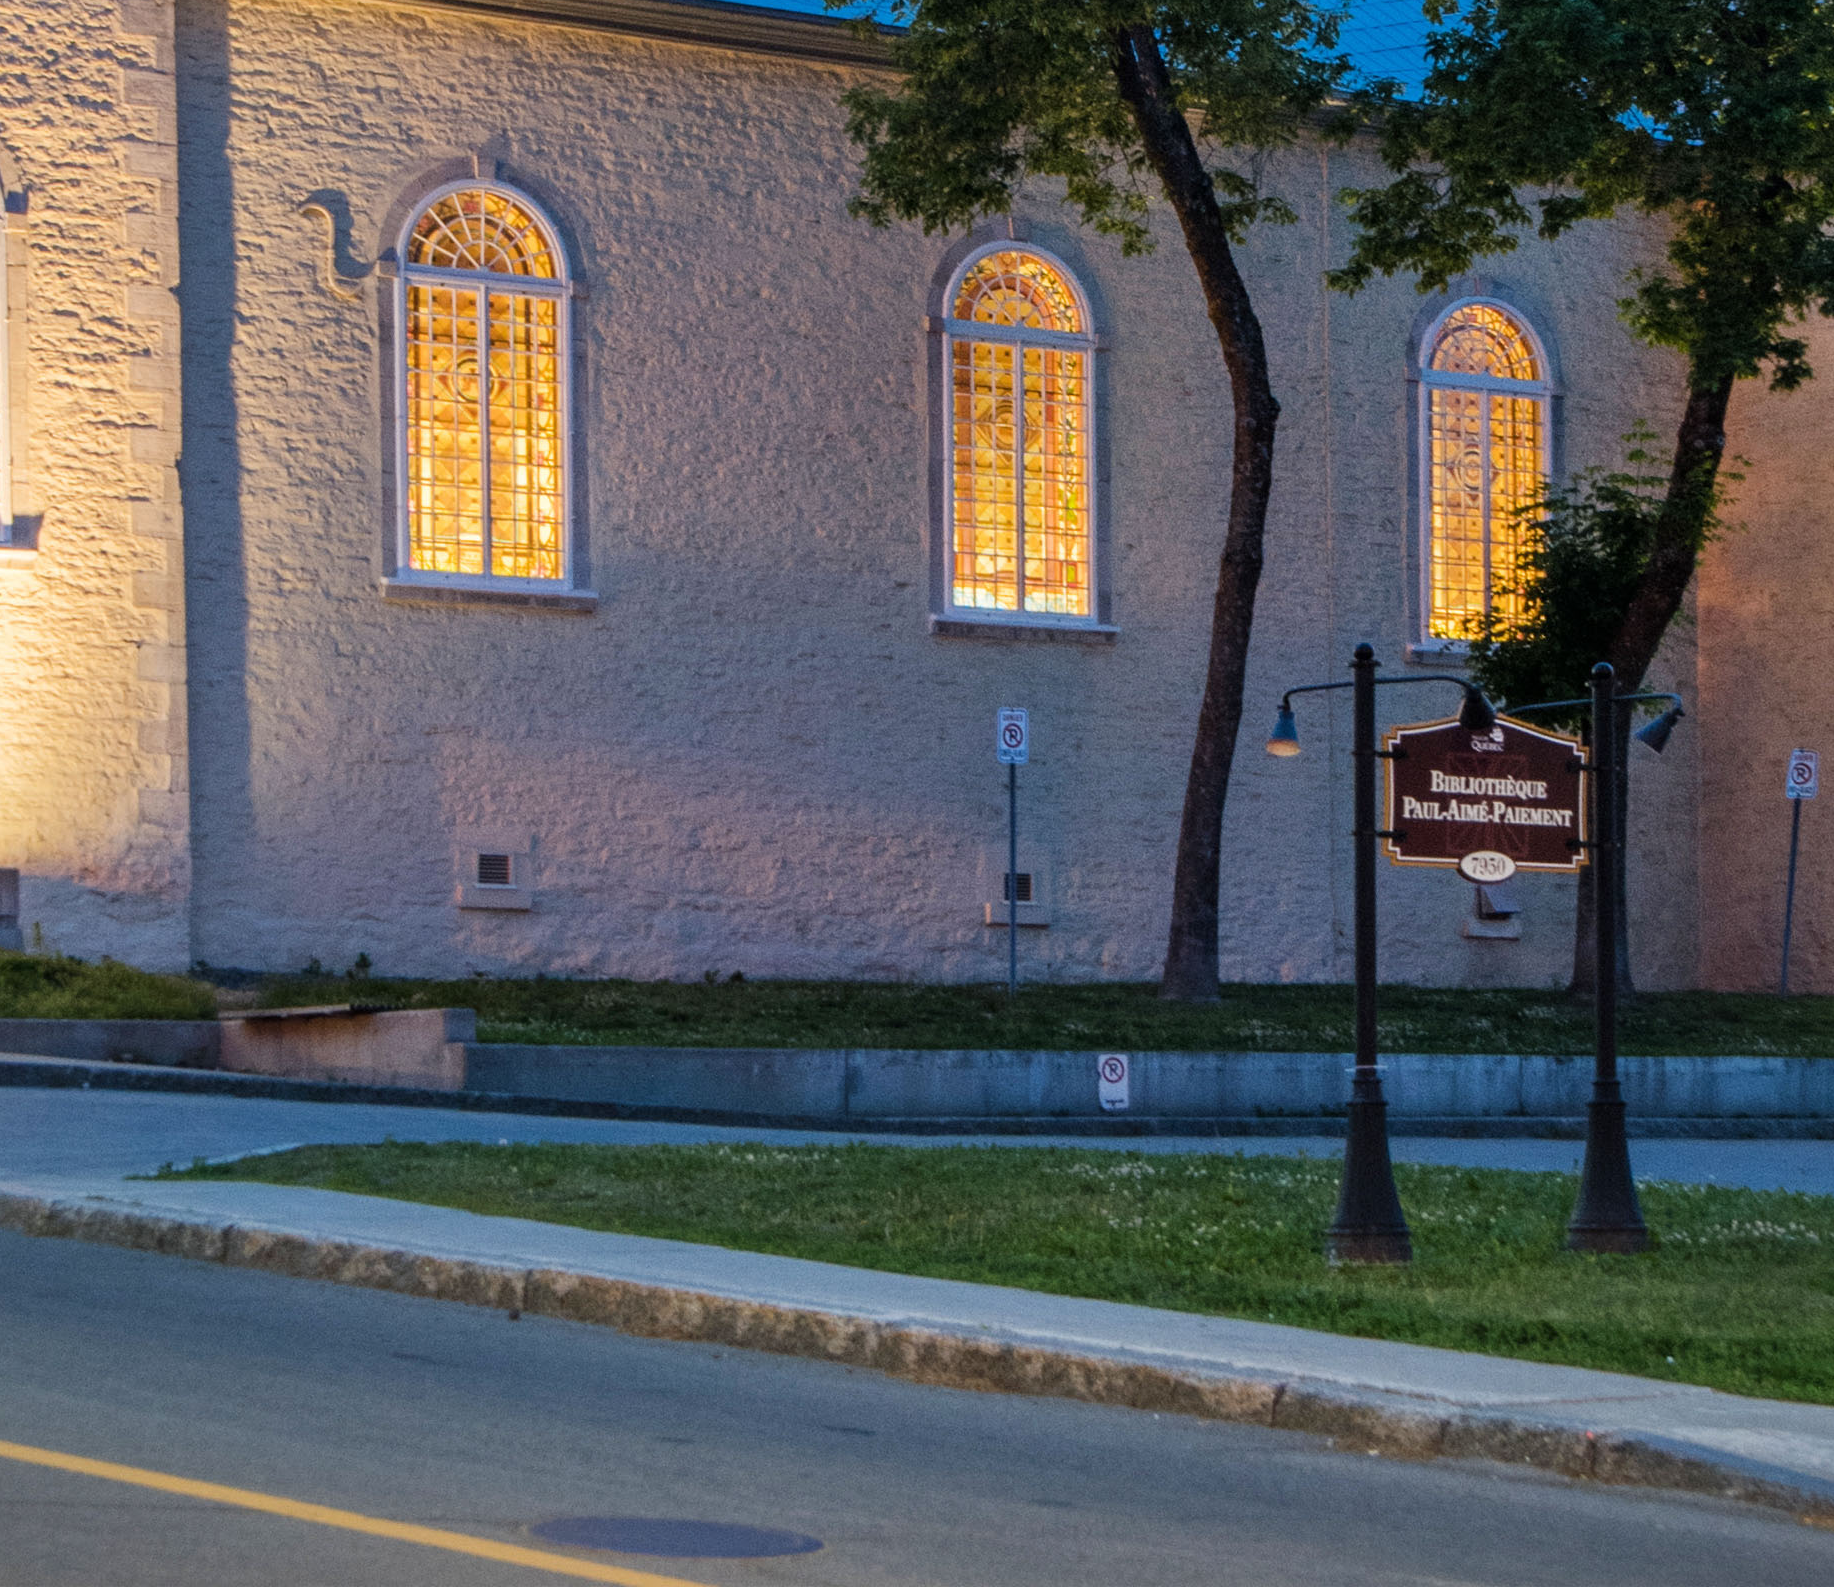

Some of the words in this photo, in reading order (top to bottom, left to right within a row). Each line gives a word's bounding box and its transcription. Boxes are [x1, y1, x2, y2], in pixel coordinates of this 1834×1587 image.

[1429, 770, 1548, 800] BIBLIOTHÈQUE
[1402, 796, 1573, 827] PAUL-AIMÉ-PAIEMENT
[1471, 857, 1506, 875] 7950
